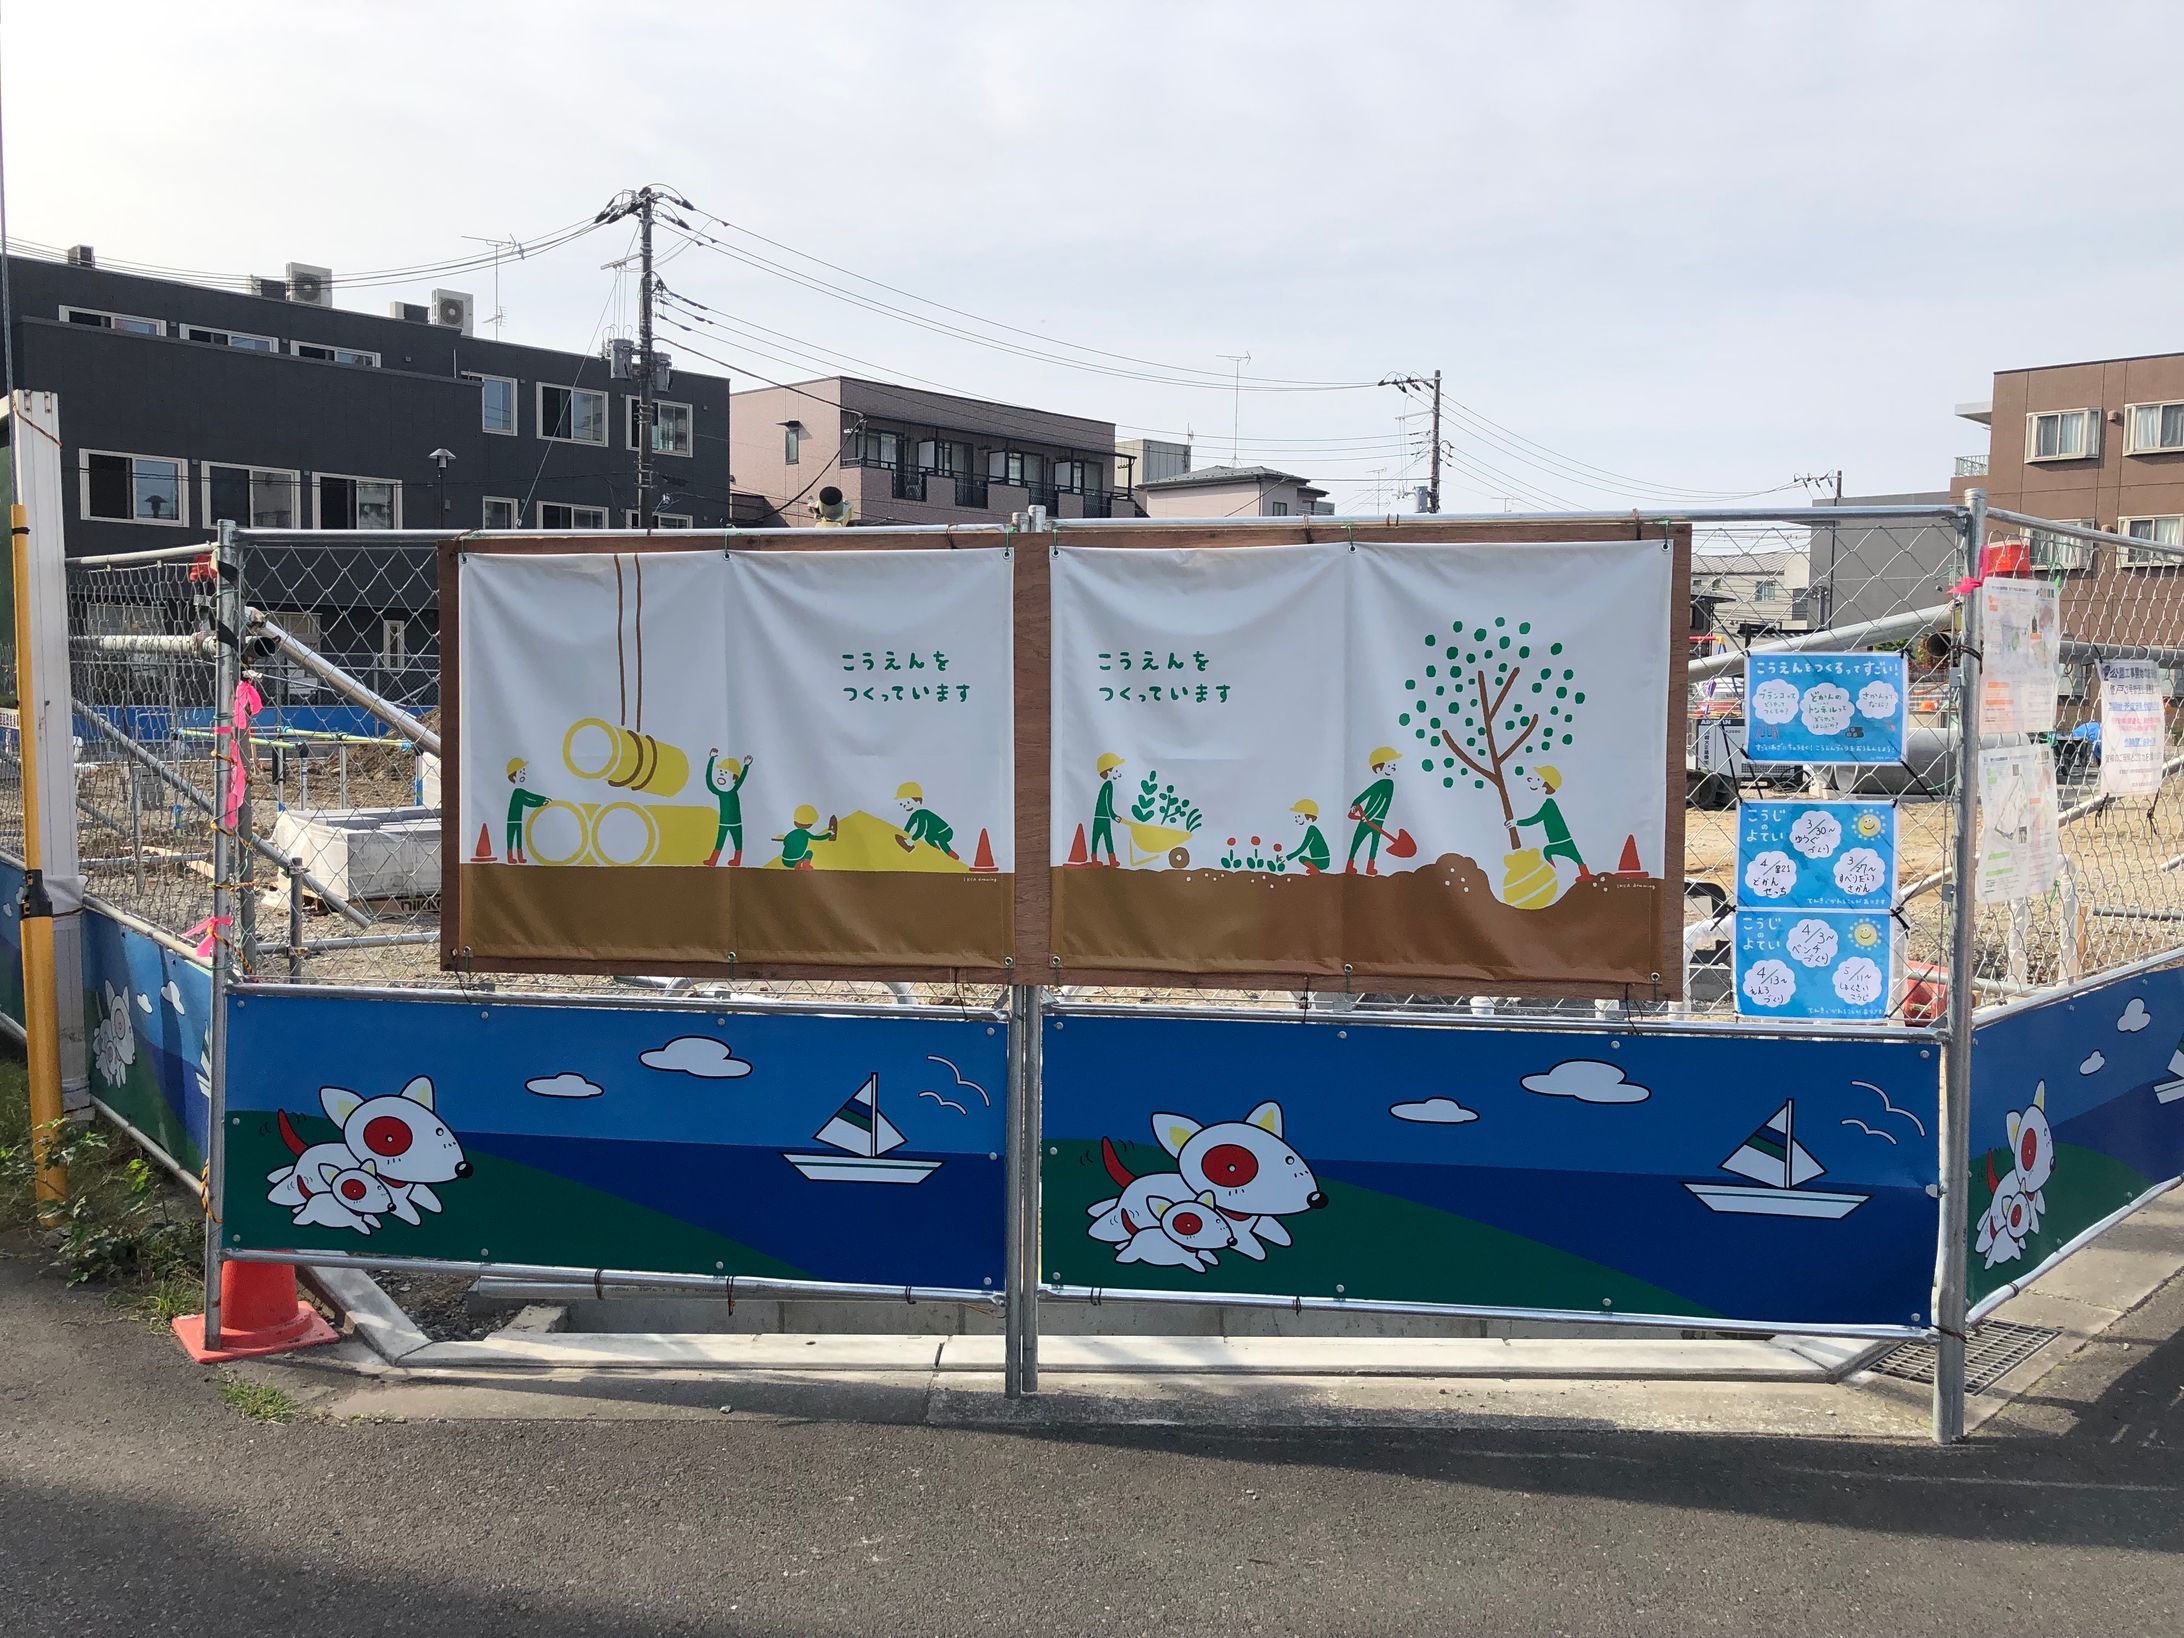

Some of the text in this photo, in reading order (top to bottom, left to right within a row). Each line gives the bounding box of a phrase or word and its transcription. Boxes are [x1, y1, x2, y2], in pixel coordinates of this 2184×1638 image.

[841, 650, 950, 672] こうえんを
[1098, 650, 1210, 672] こうえんを
[842, 683, 971, 703] つくっています
[1098, 683, 1231, 703] つくっています
[1811, 690, 1842, 702] どかんの
[1808, 703, 1847, 714] トンネルって
[1747, 808, 1786, 823] こうじ
[1746, 830, 1784, 843] よてい
[1753, 877, 1779, 887] どかん
[1847, 883, 1871, 893] さかん
[1742, 917, 1782, 931] こうじ
[1742, 937, 1781, 951] よてい
[1792, 943, 1821, 954] ベンチ
[1803, 953, 1829, 965] づくり
[1850, 993, 1870, 1002] こうじ
